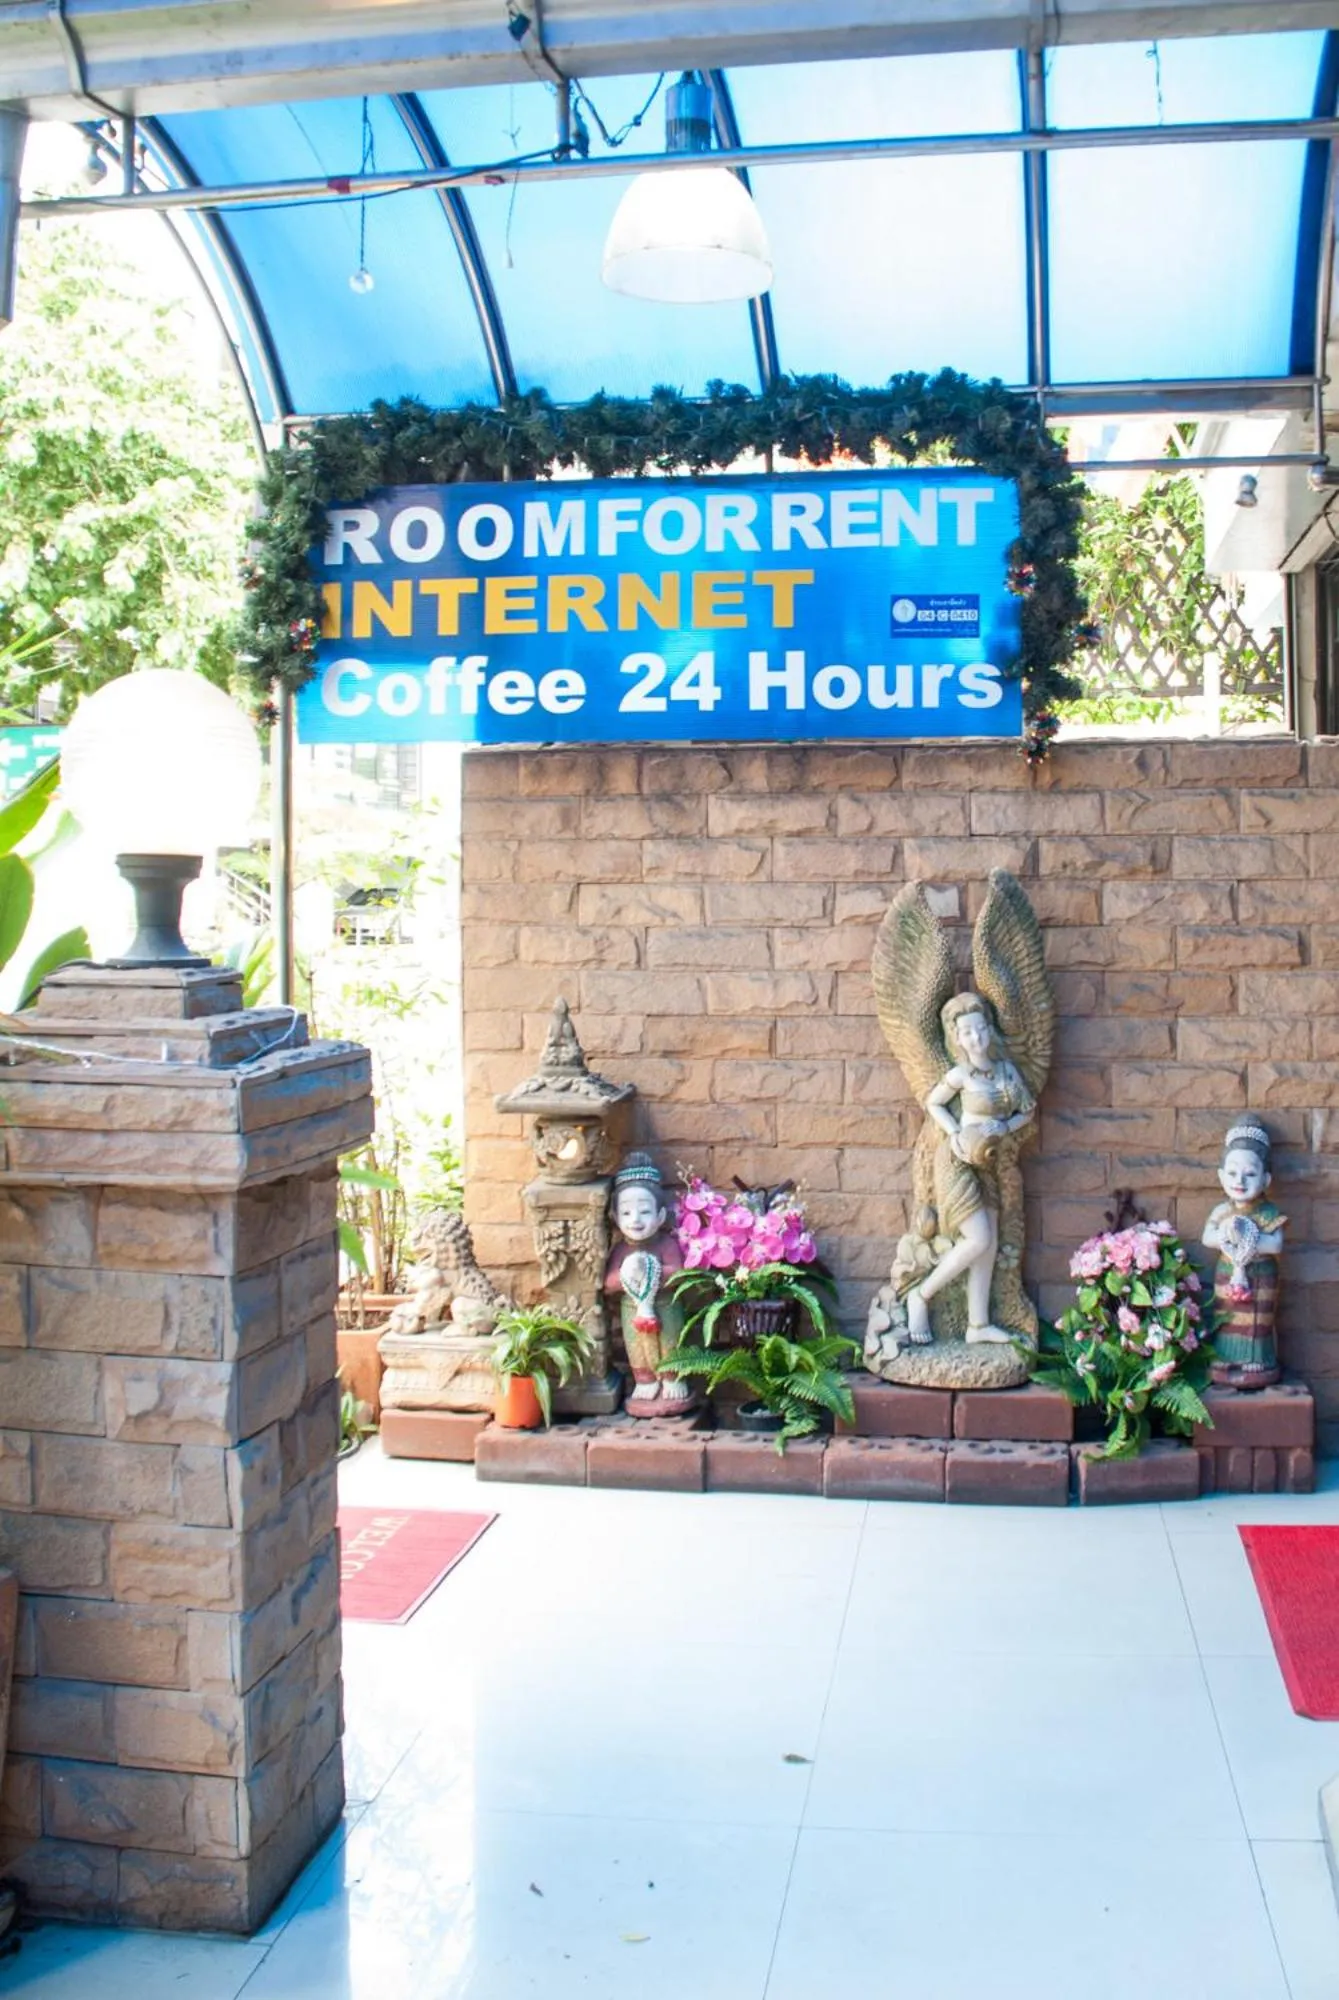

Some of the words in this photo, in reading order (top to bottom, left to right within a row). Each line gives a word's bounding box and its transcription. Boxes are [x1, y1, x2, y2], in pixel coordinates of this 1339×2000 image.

[321, 569, 814, 640] INTERNET
[321, 656, 585, 717] Coffee
[618, 651, 722, 712] 24
[748, 650, 1003, 711] Hours
